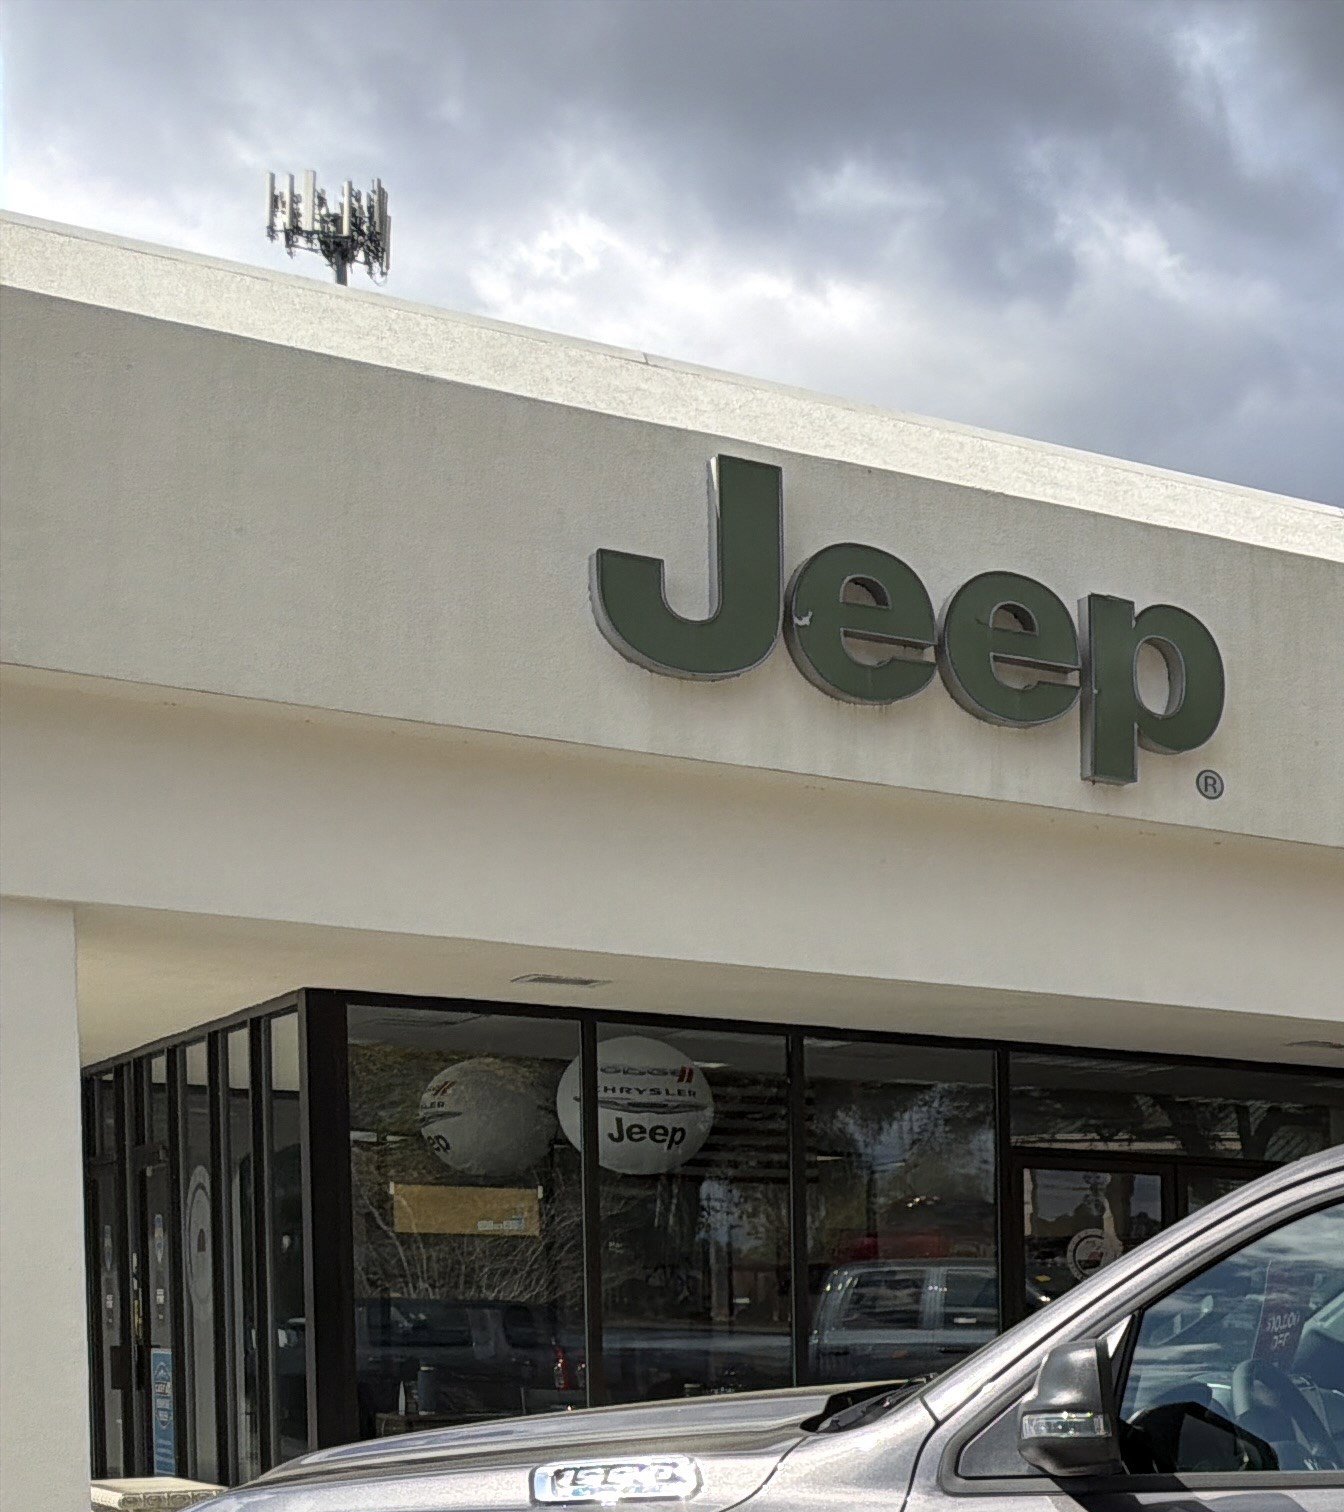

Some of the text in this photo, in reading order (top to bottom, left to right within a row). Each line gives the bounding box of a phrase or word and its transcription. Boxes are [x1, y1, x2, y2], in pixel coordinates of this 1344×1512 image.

[588, 453, 1226, 785] Jeep
[598, 1085, 697, 1099] HRYSLER
[608, 1117, 687, 1151] Jeep
